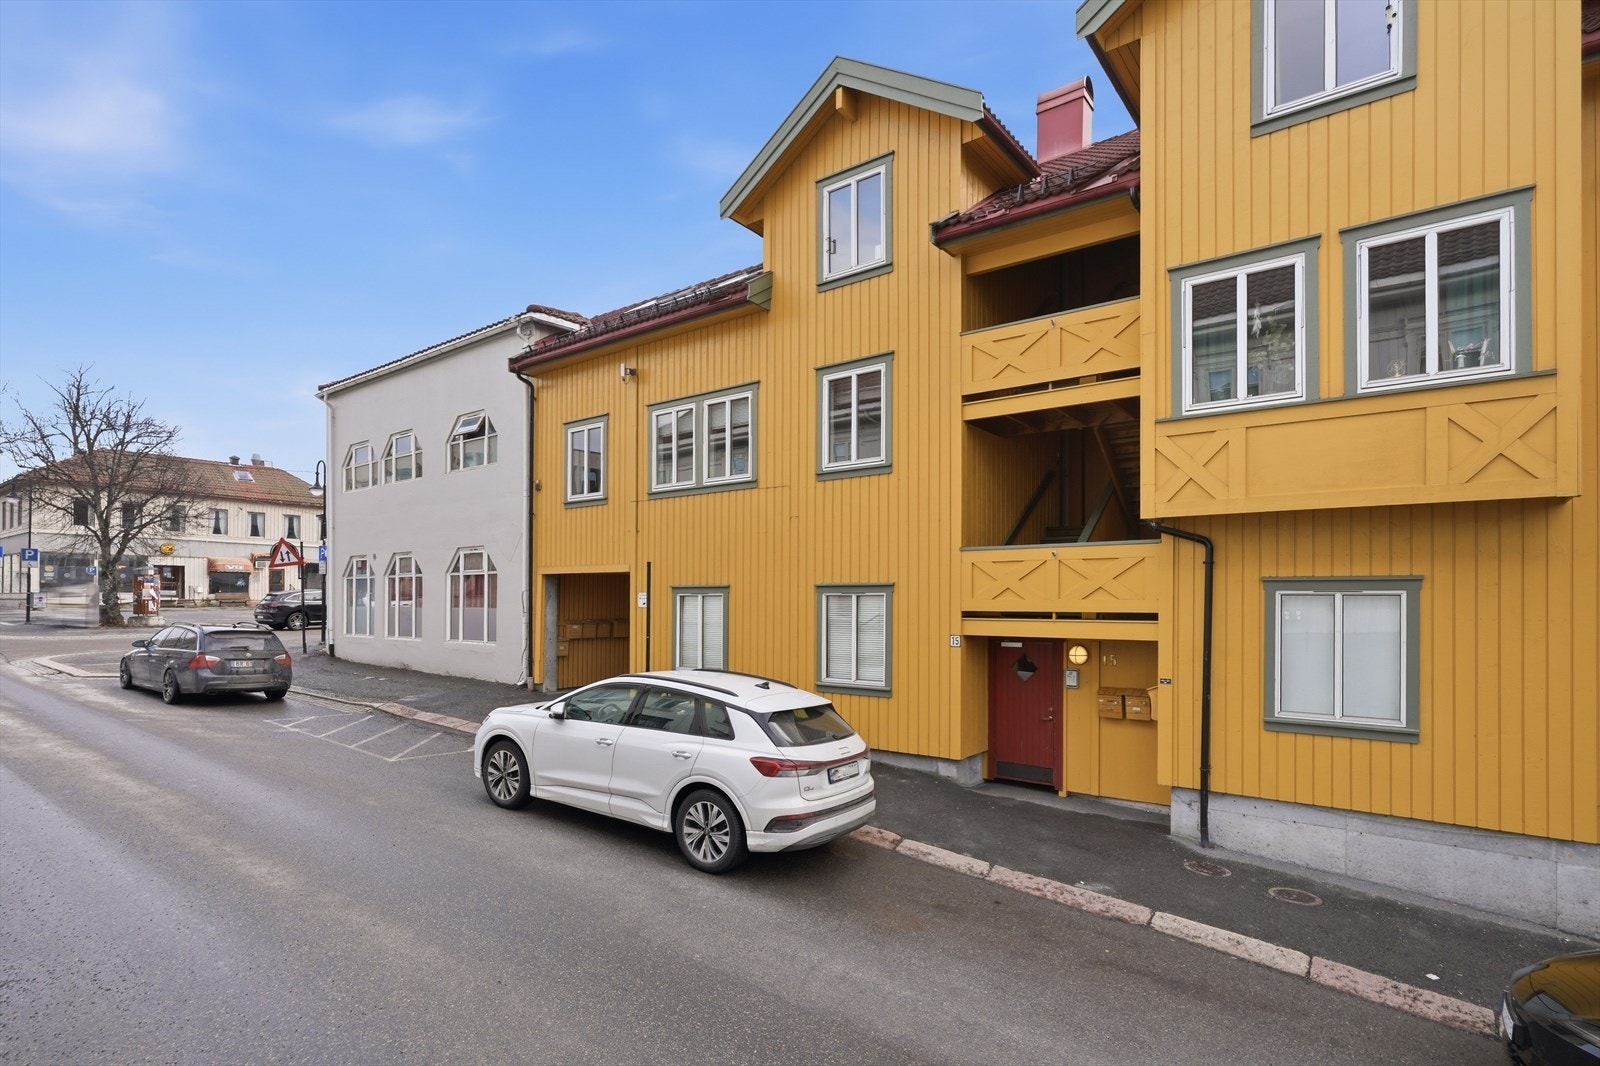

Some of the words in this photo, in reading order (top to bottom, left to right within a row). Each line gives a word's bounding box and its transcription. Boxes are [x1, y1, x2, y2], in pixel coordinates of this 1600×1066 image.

[25, 550, 34, 559] P
[951, 636, 960, 645] 15
[1103, 655, 1117, 665] 15
